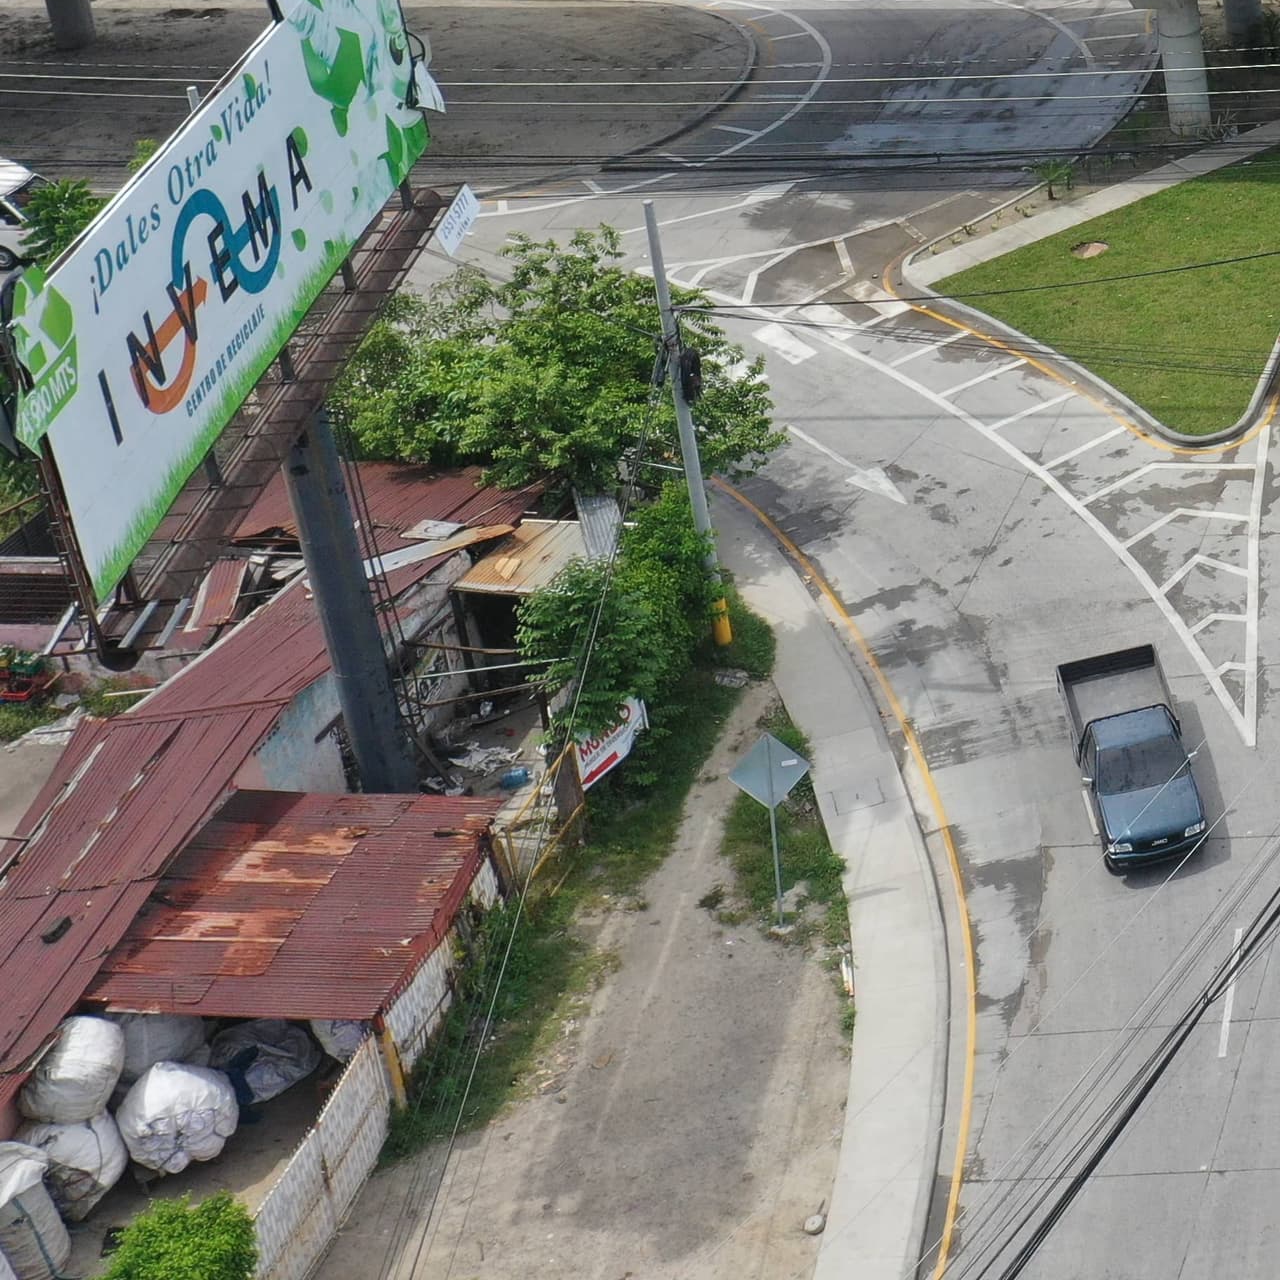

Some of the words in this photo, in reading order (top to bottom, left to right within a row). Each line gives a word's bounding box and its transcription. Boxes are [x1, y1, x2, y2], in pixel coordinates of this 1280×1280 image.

[91, 203, 162, 315] ¡Dales
[167, 137, 218, 206] Otra
[219, 59, 272, 146] Vida!
[49, 355, 77, 405] MTS
[98, 132, 313, 447] INVEMA
[185, 367, 218, 418] CENTRO
[215, 353, 228, 377] DE
[225, 303, 266, 363] RECICLAJE
